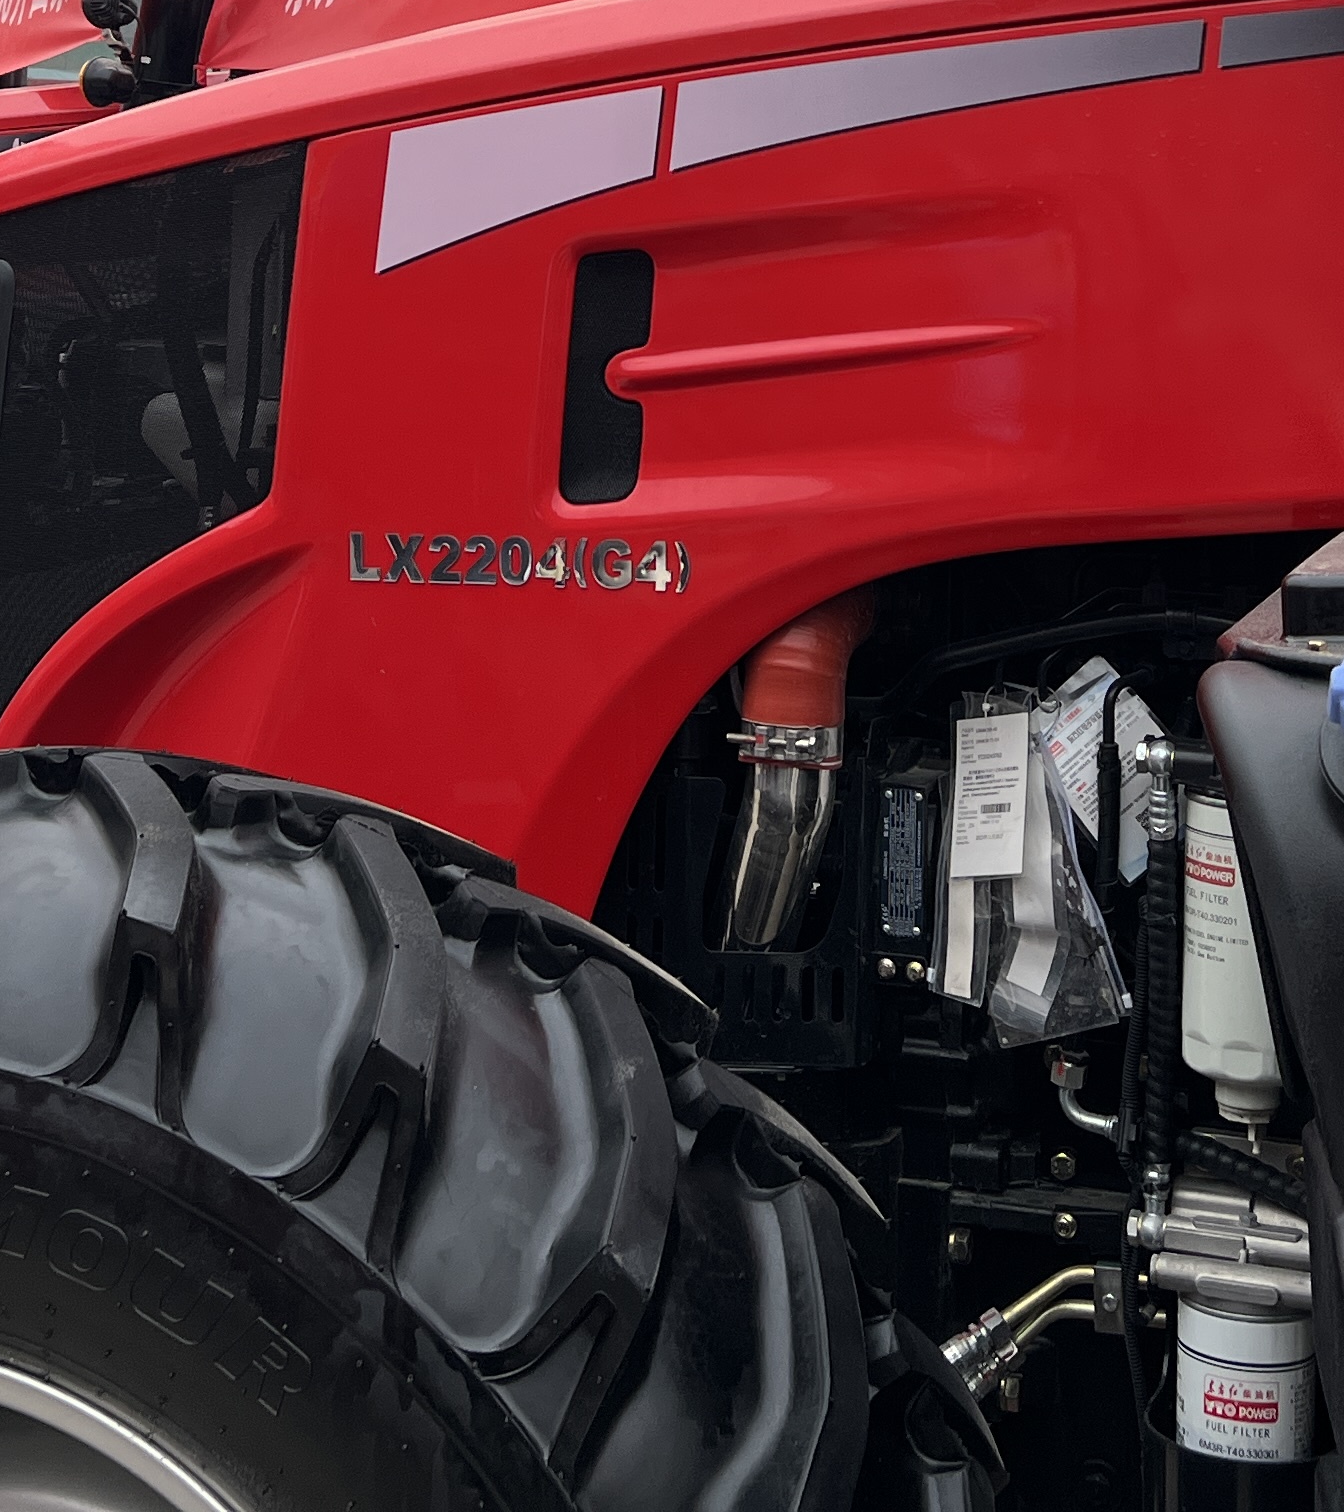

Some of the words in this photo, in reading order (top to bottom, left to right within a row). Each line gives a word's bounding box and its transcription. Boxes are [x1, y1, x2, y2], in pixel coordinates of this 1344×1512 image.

[348, 530, 692, 594] LX2204(G4)
[1200, 867, 1234, 884] POWER
[1199, 890, 1229, 906] FILTER
[1238, 1405, 1277, 1420] POWER
[1205, 1419, 1228, 1435] FUEL
[1232, 1426, 1271, 1439] FILTER
